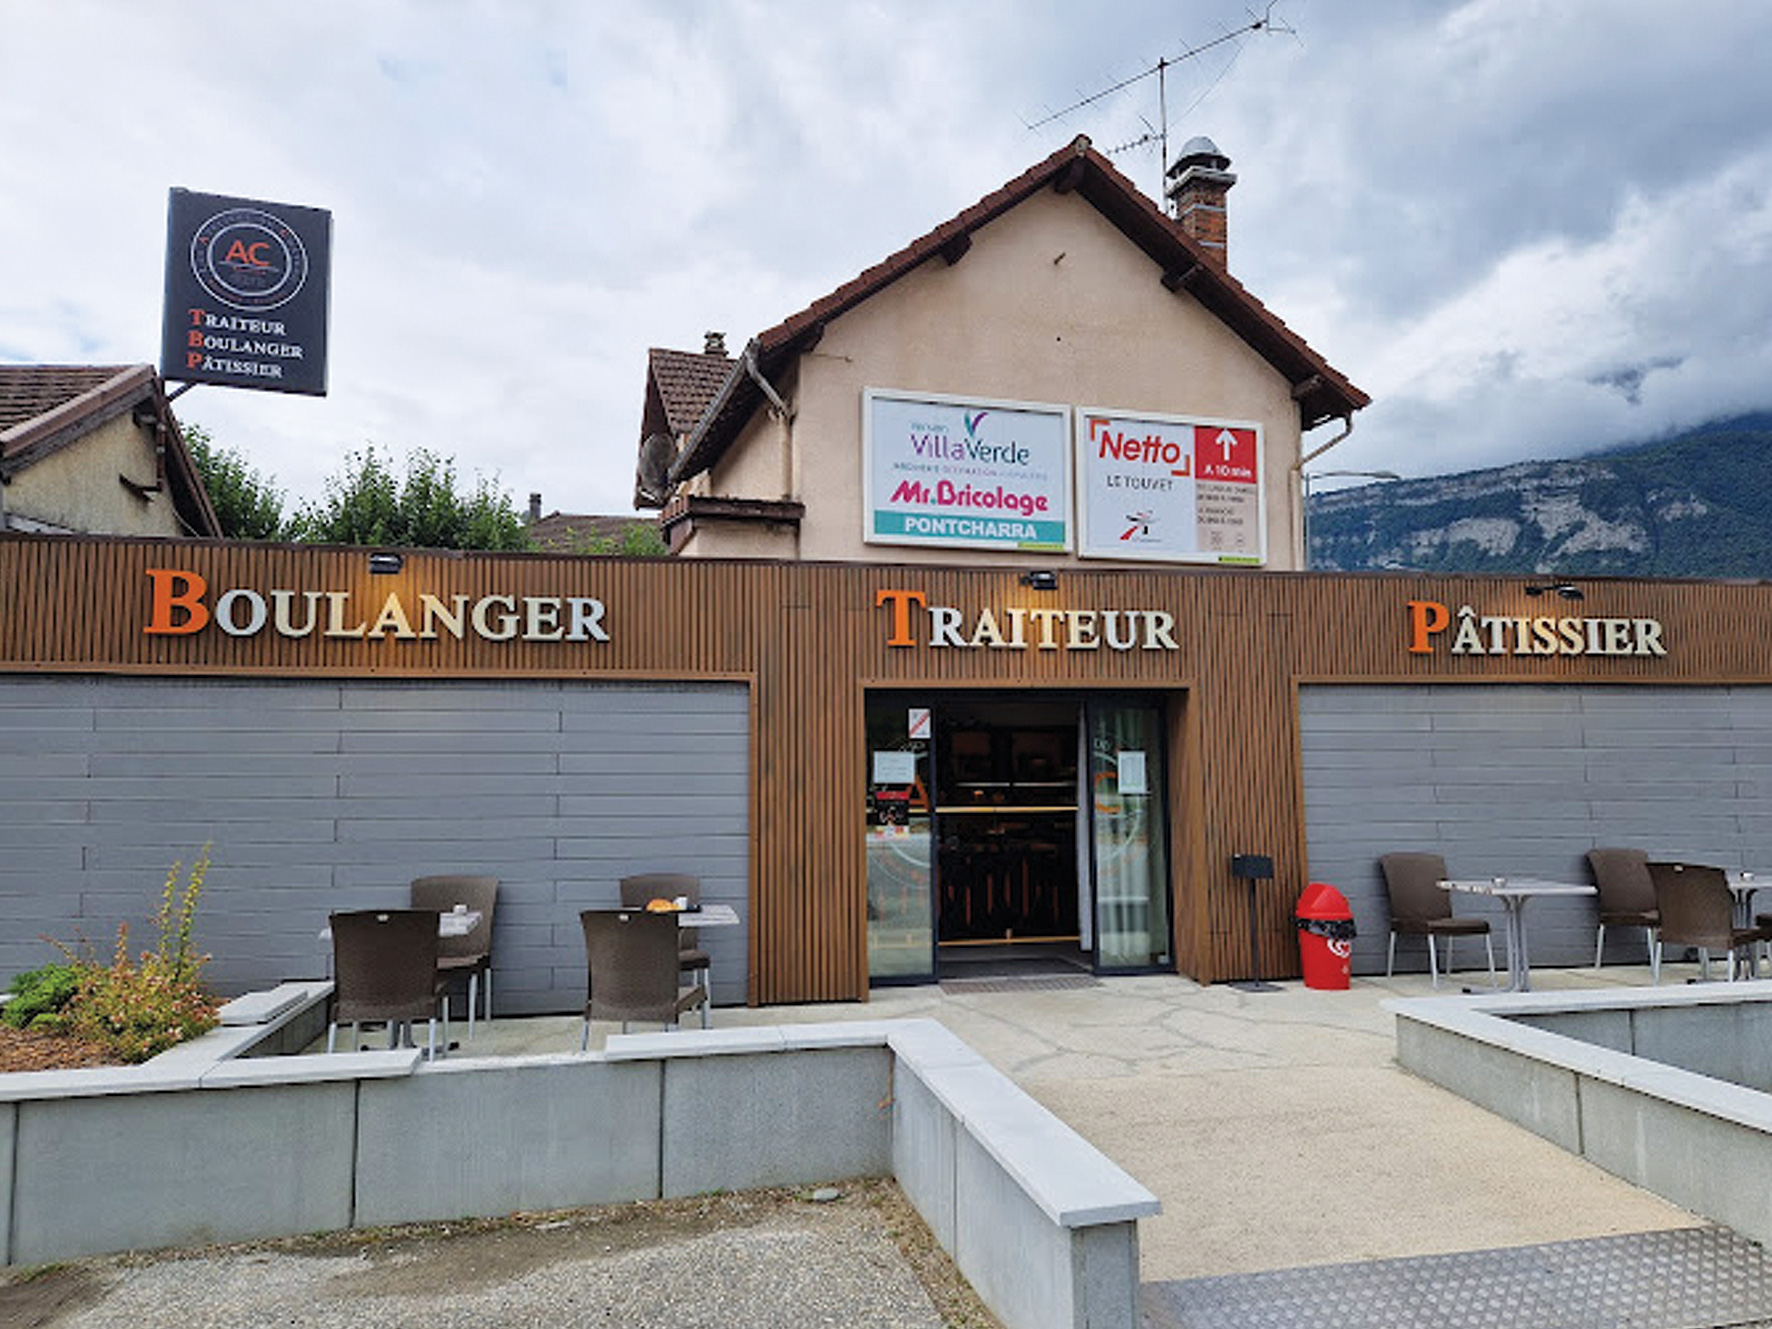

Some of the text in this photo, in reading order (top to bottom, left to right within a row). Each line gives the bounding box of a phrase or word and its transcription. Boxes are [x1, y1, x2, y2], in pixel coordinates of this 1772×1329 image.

[226, 239, 271, 267] AC
[188, 309, 287, 336] TRAITEUR
[187, 330, 304, 359] BOULANGER
[186, 353, 284, 379] PÂTISSIER
[910, 433, 1031, 466] VillaVerde
[1099, 430, 1180, 464] Netto
[1106, 475, 1121, 488] LE
[904, 516, 1038, 540] PONTCHARRA
[143, 568, 611, 642] BOULANGER
[875, 589, 1180, 650] TRAITEUR
[1406, 600, 1668, 656] PÂTISSIER
